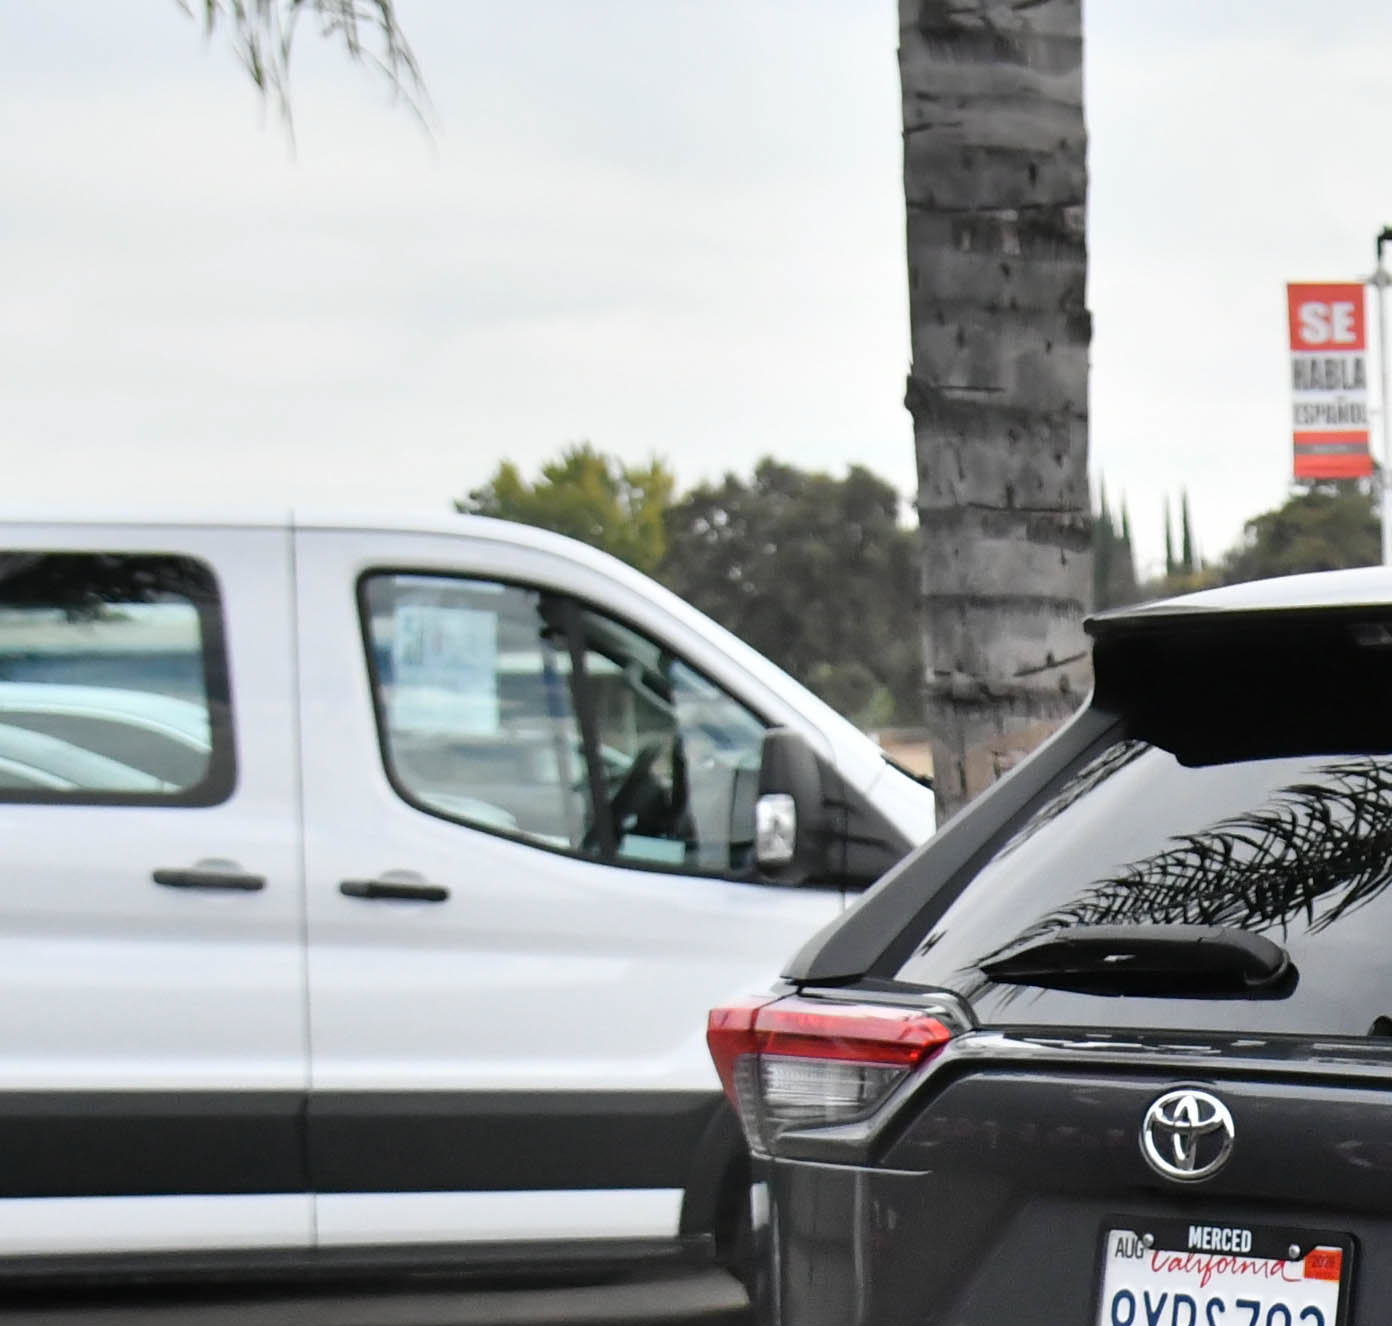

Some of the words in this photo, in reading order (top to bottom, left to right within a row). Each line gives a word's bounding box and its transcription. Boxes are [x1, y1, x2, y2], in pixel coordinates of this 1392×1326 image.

[1299, 301, 1357, 344] SE
[1292, 357, 1367, 390] HABLA
[1114, 1237, 1145, 1259] AUG
[1188, 1225, 1252, 1253] MERCED
[1151, 1250, 1302, 1288] California
